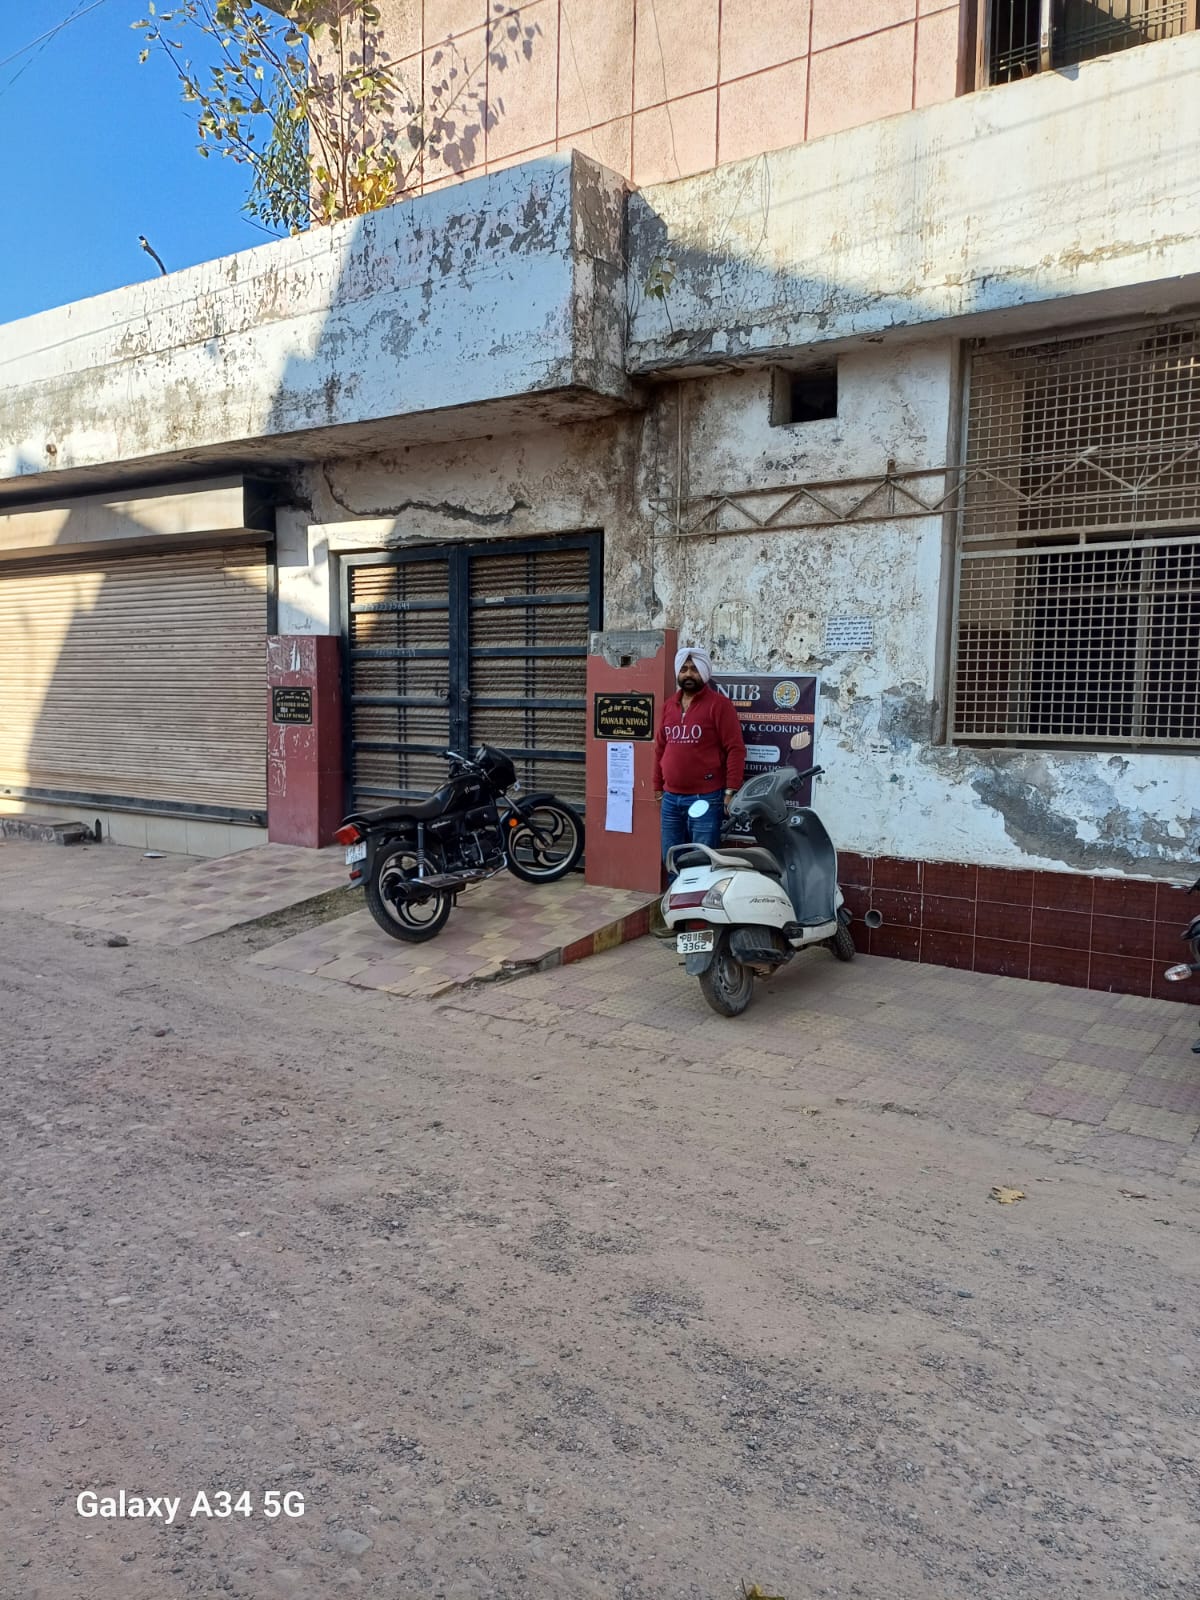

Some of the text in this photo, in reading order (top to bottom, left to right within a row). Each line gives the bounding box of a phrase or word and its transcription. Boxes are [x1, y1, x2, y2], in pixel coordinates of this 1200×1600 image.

[600, 717, 648, 726] PAWAR NIWAS
[664, 724, 702, 741] POLO
[682, 941, 706, 952] 3362
